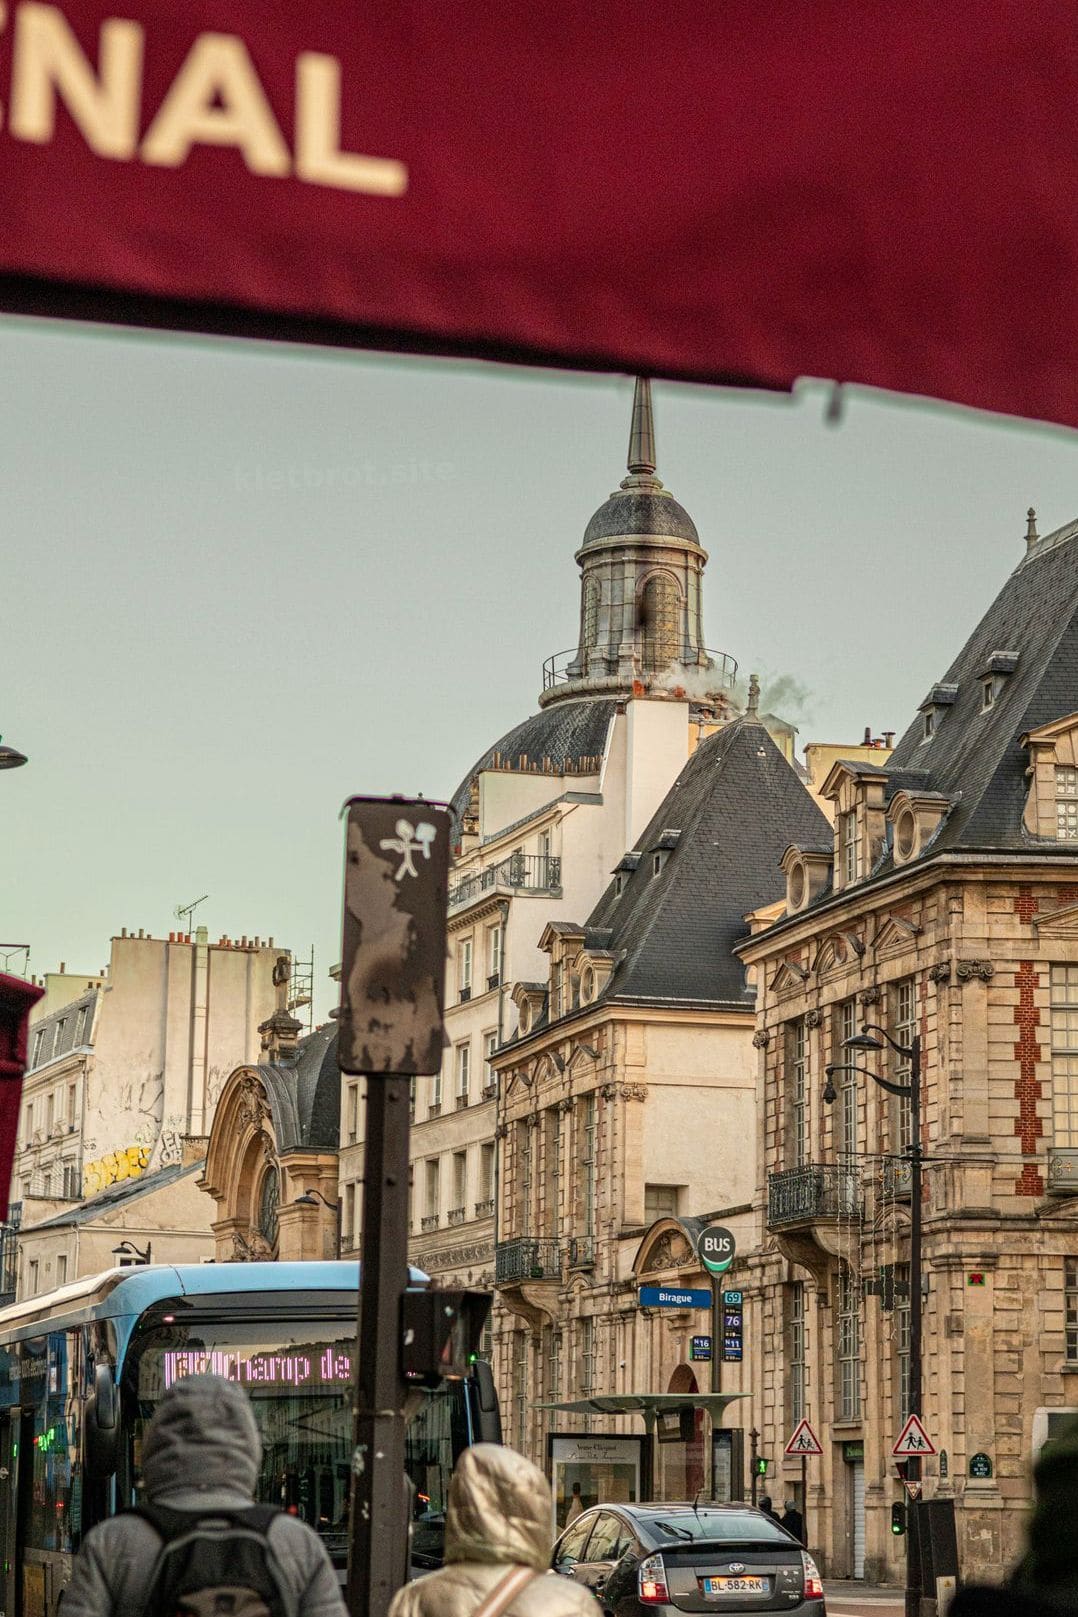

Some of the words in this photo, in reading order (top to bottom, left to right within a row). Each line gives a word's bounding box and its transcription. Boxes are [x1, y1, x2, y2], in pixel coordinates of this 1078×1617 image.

[0, 0, 408, 197] NAL
[704, 1238, 731, 1251] BUS
[659, 1293, 693, 1303] Birague
[727, 1292, 740, 1304] 69
[726, 1316, 740, 1326] 76
[321, 1349, 350, 1380] de
